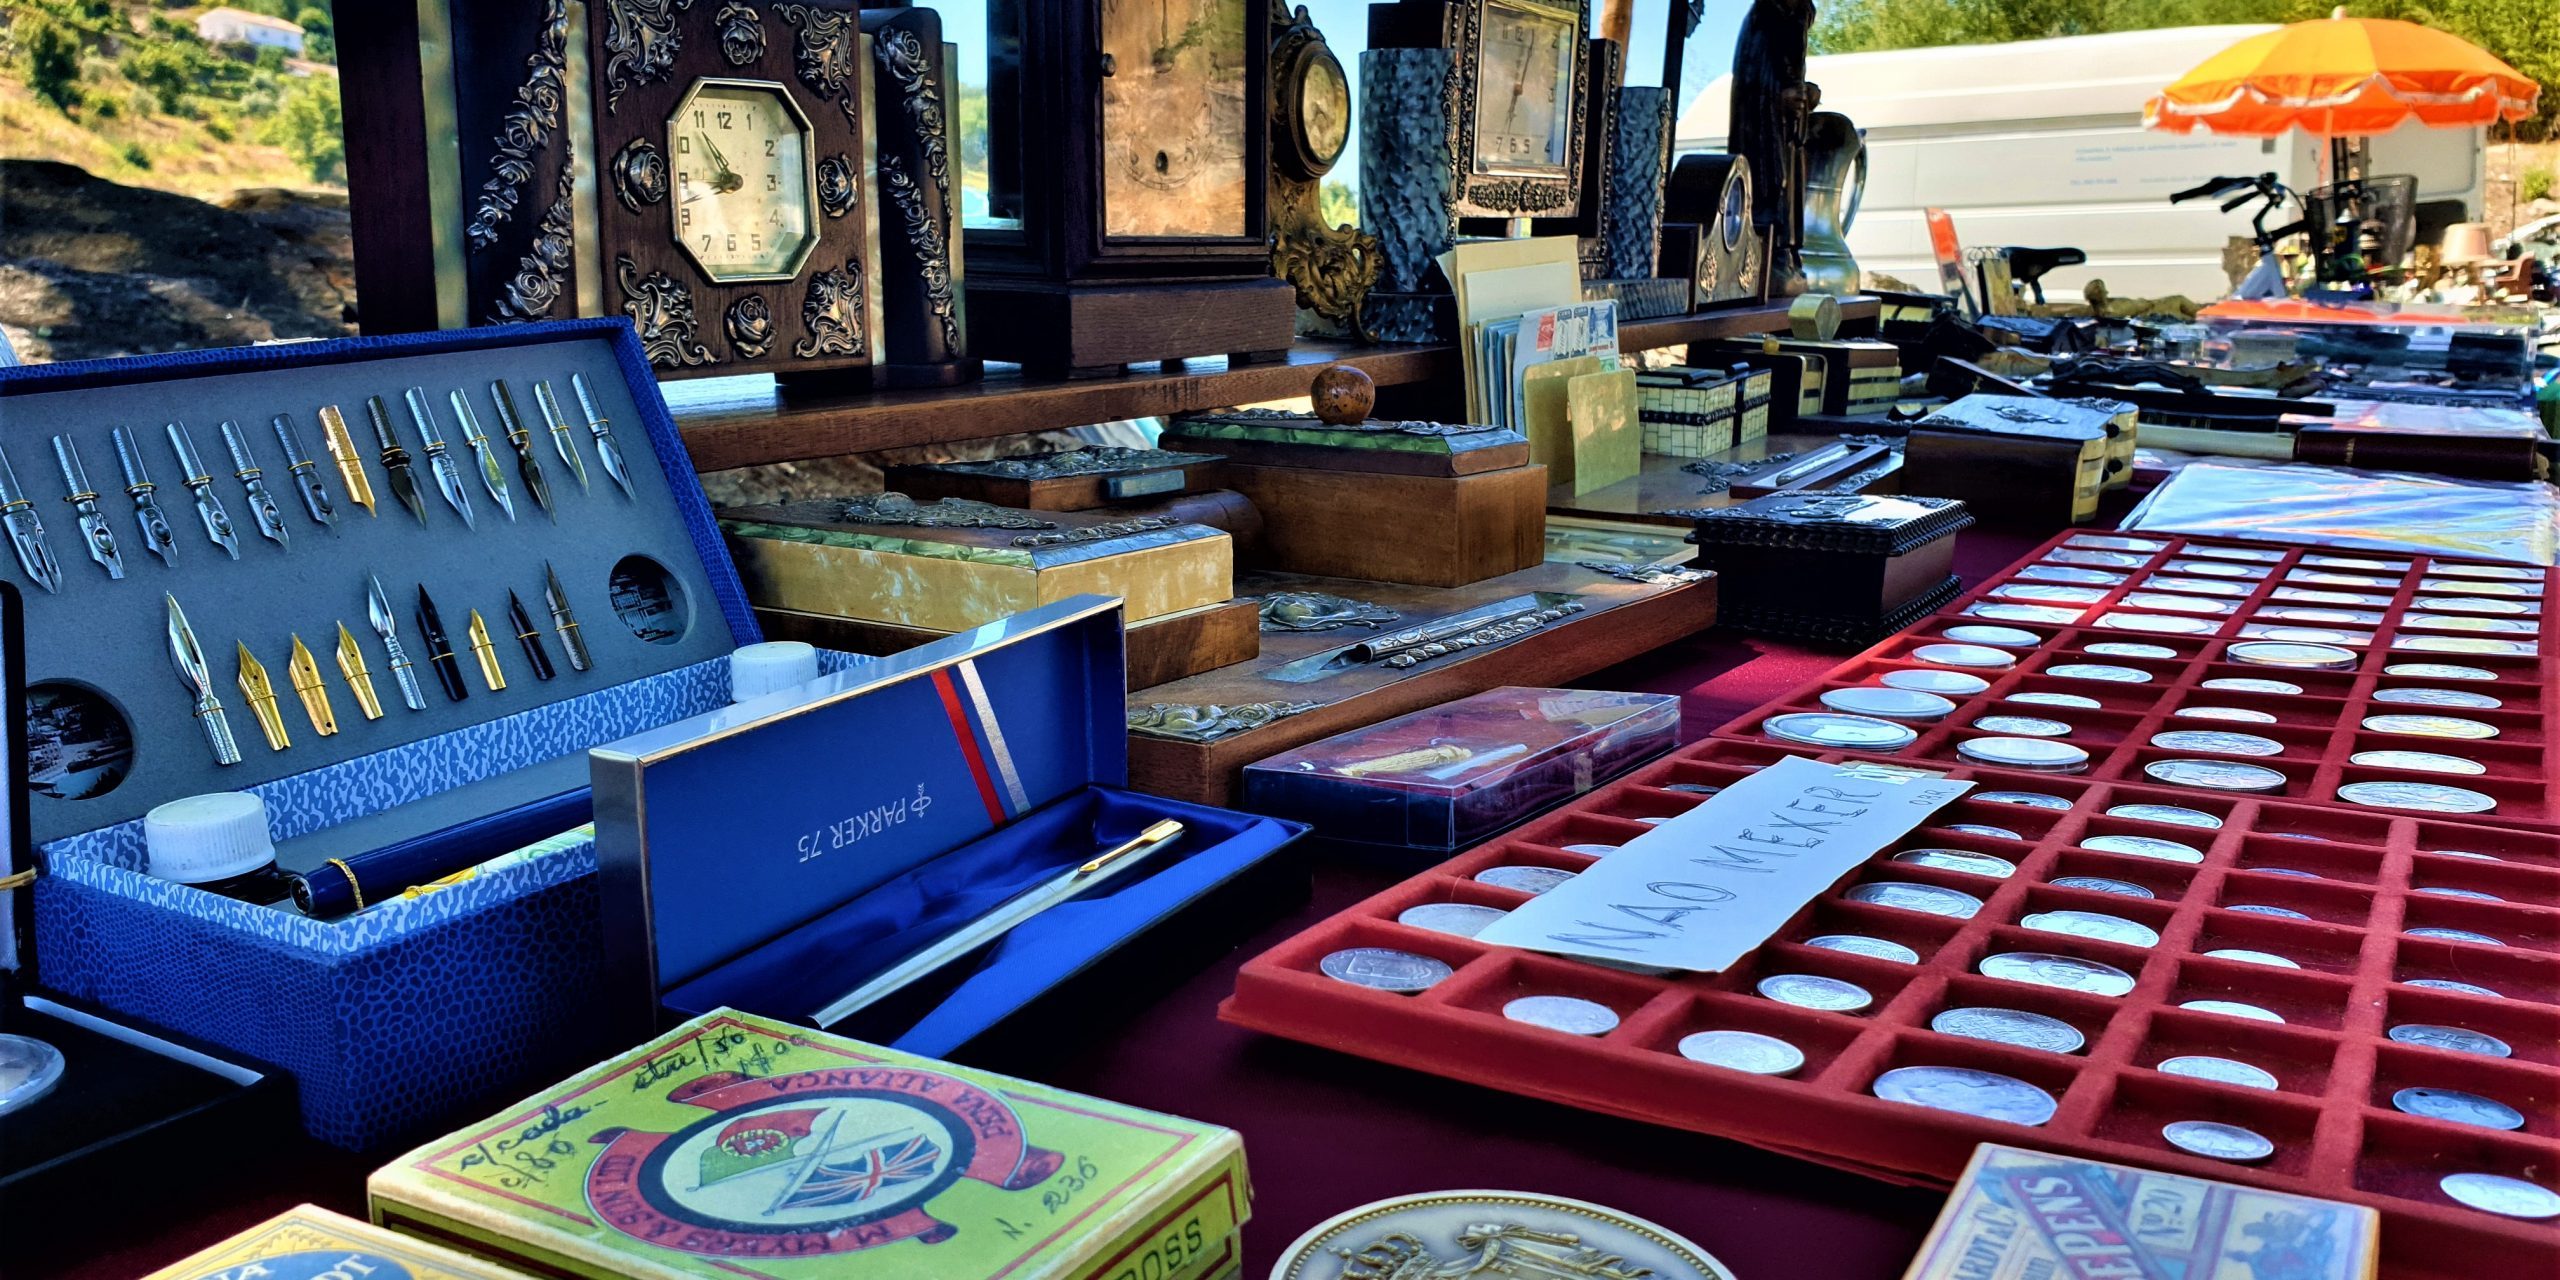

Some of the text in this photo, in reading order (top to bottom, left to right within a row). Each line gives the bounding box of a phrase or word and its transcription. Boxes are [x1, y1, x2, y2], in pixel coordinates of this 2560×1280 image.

[693, 110, 705, 129] 11
[717, 112, 732, 130] 12
[746, 113, 752, 131] 1
[765, 140, 775, 157] 2
[766, 174, 777, 191] 3
[769, 209, 780, 226] 4
[702, 234, 712, 253] 7
[726, 233, 737, 251] 6
[751, 233, 761, 251] 5
[797, 797, 906, 863] PARKER 75
[1688, 785, 1883, 875] MEXER
[1041, 1154, 1098, 1216] 236
[1115, 1215, 1203, 1280] OSS
